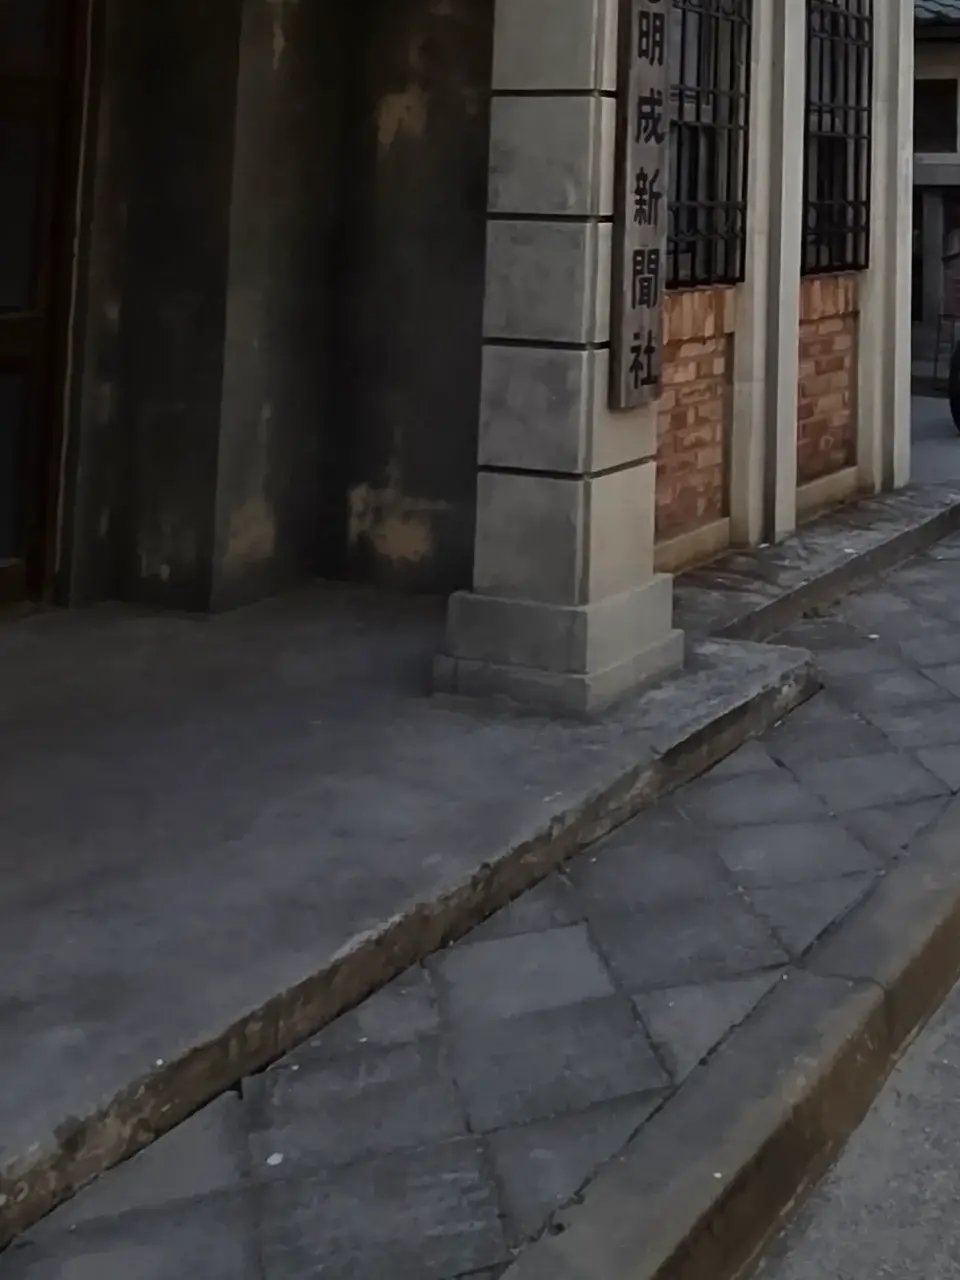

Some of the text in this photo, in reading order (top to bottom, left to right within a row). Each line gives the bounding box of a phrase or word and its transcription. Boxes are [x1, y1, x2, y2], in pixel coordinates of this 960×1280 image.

[629, 10, 665, 389] 明成新聞社
